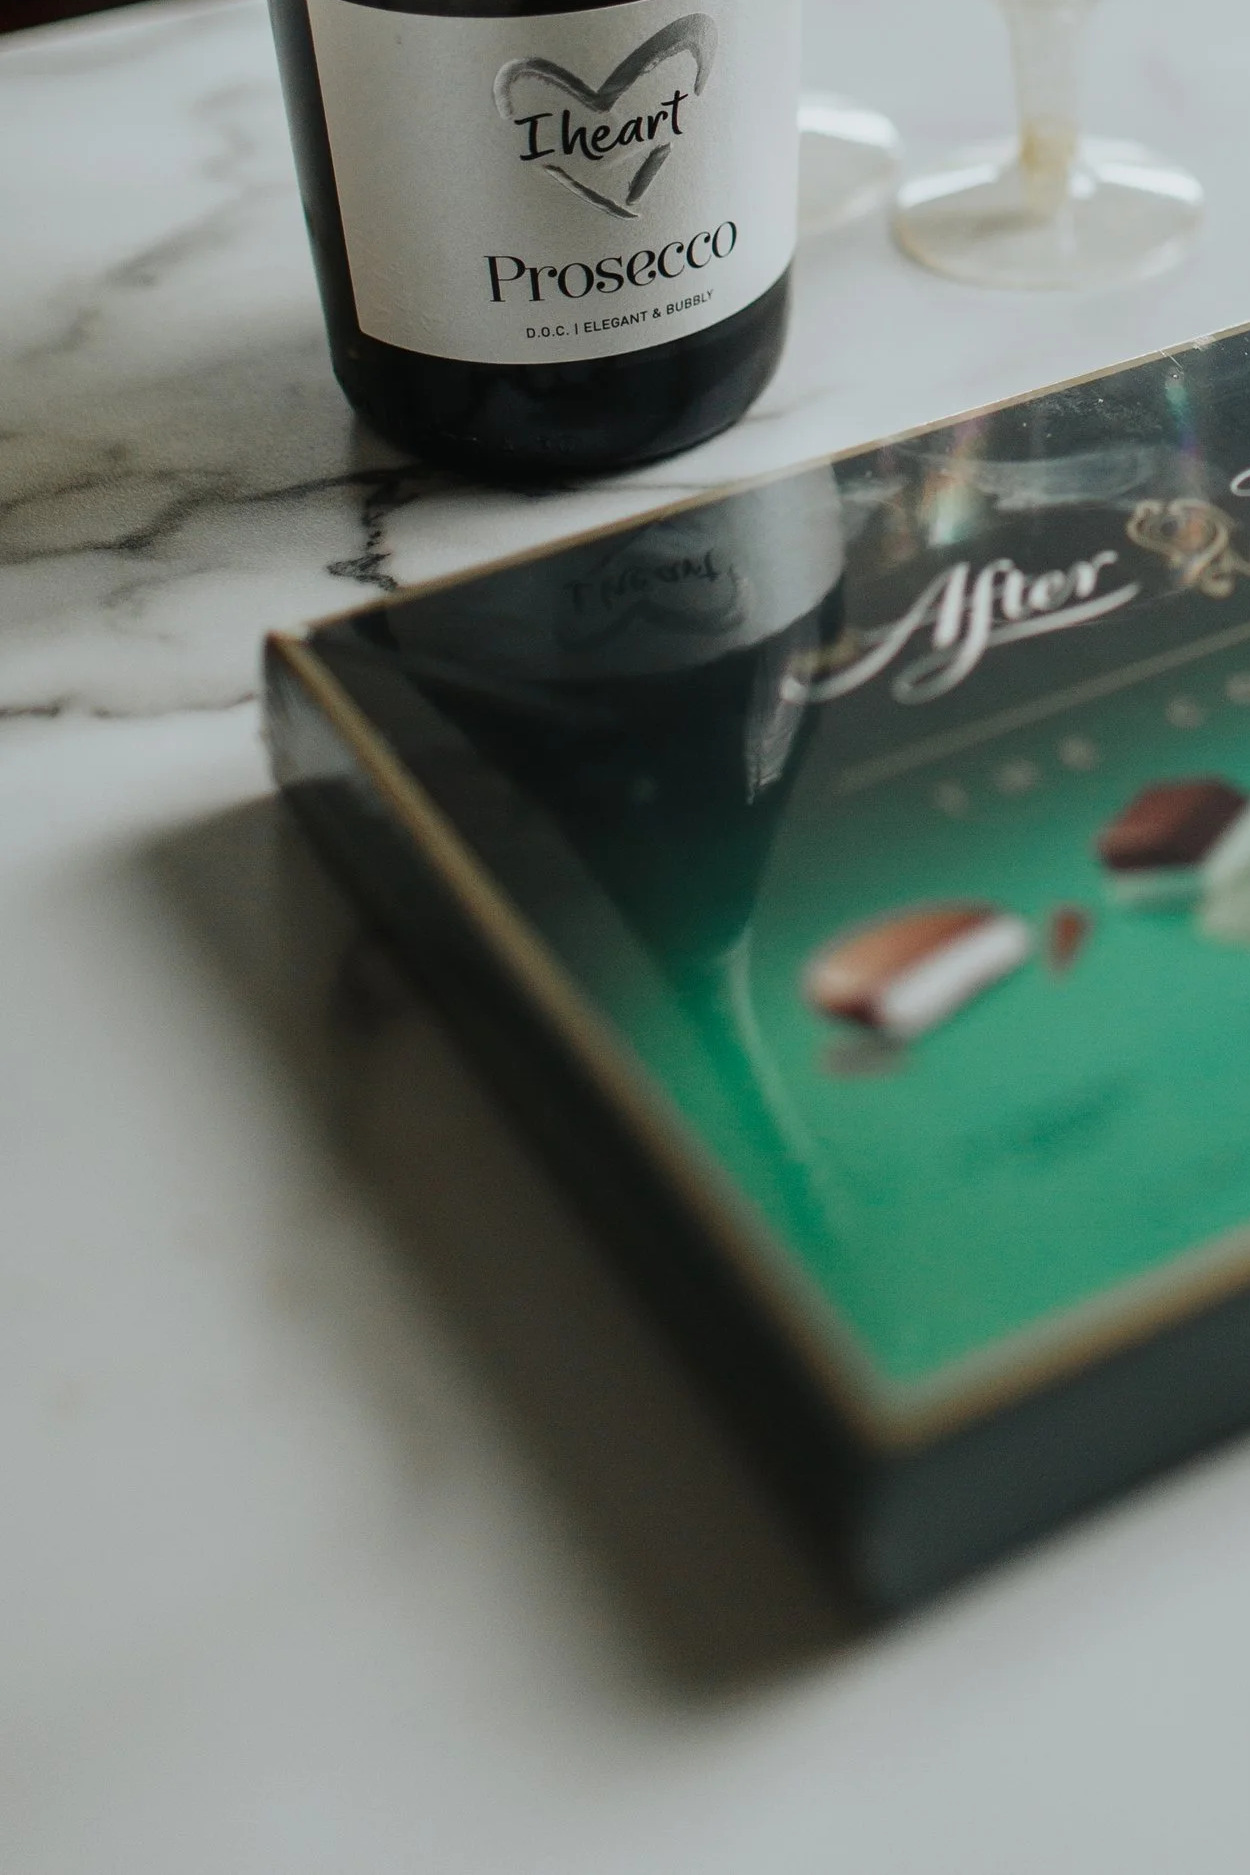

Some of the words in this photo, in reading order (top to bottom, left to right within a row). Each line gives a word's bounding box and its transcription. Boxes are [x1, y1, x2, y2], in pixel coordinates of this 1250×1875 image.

[484, 220, 738, 303] Prosecco
[526, 325, 570, 339] D.O.C.
[584, 310, 648, 333] ELEGANT
[652, 308, 662, 319] &
[666, 288, 714, 315] BUBBLY
[779, 550, 1141, 705] After
